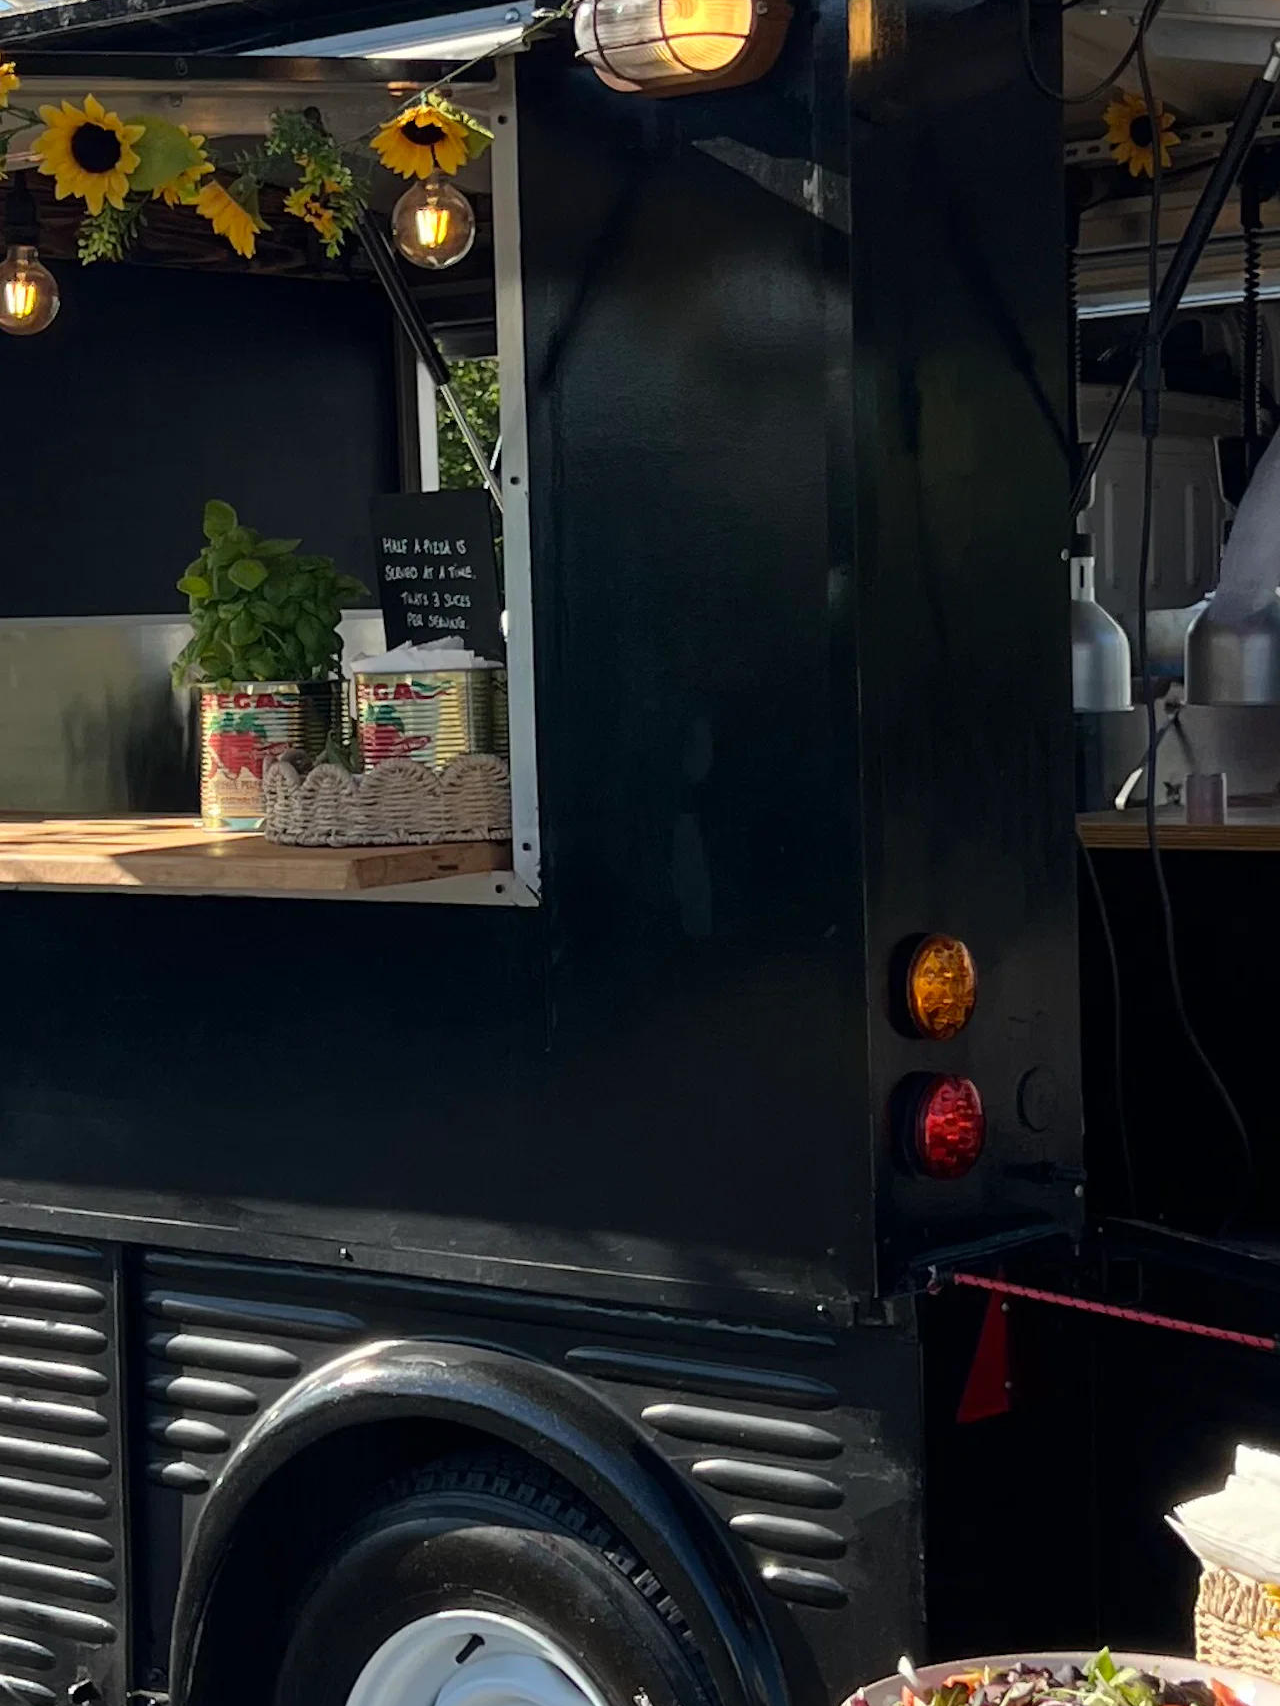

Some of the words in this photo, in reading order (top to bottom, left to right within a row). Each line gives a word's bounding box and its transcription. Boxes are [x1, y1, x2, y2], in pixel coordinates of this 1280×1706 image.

[382, 538, 408, 554] HALF
[414, 538, 422, 554] A
[423, 538, 452, 555] PIZZA
[422, 565, 434, 580] AT
[438, 565, 446, 580] A
[432, 591, 441, 608] 3
